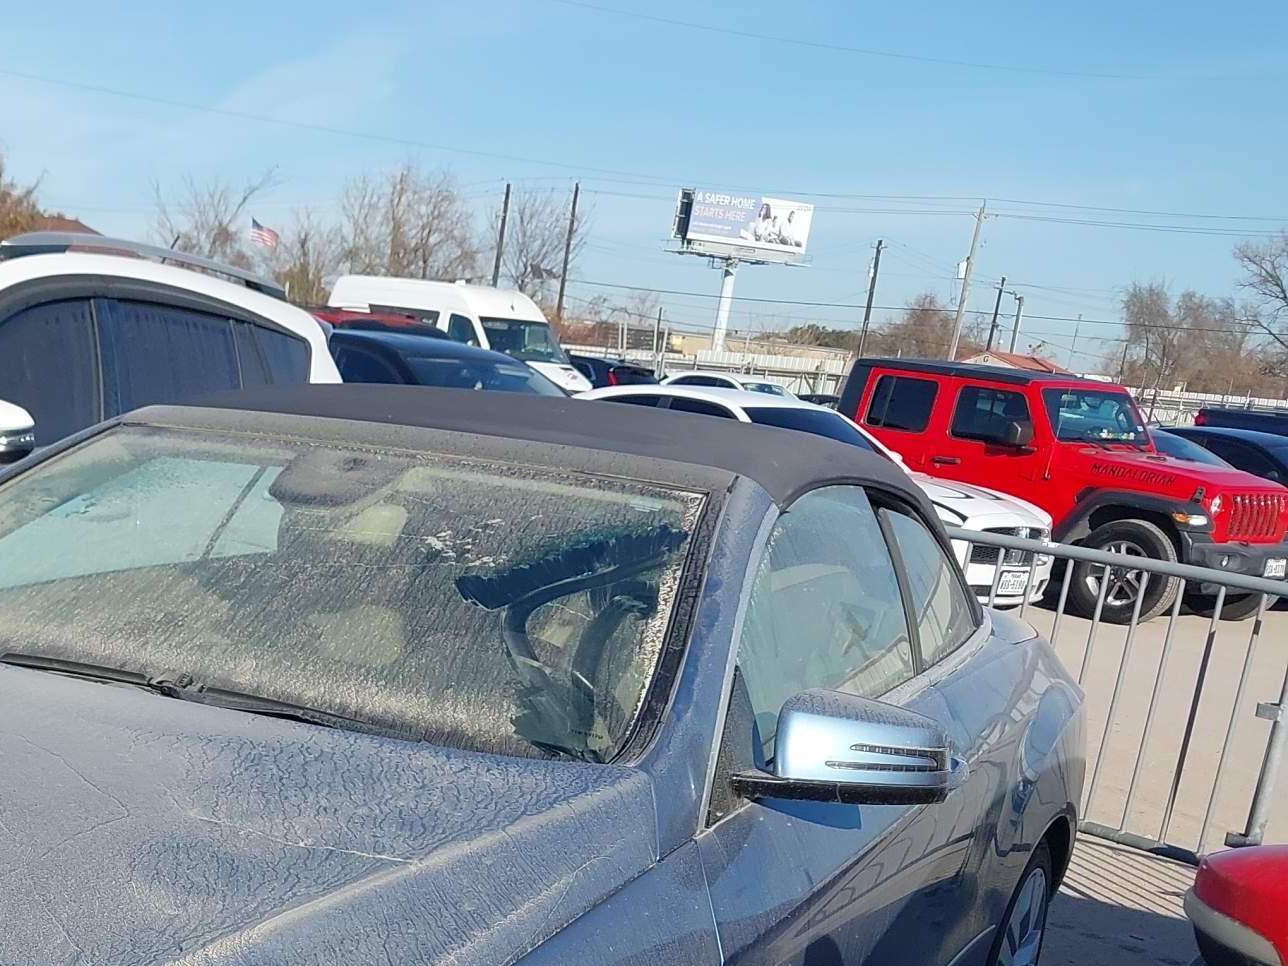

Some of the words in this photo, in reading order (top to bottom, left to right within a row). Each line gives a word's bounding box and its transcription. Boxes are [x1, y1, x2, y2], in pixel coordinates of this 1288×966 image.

[705, 192, 730, 206] SAFER
[731, 196, 756, 210] HOME
[1091, 463, 1177, 486] MANDALORIAN
